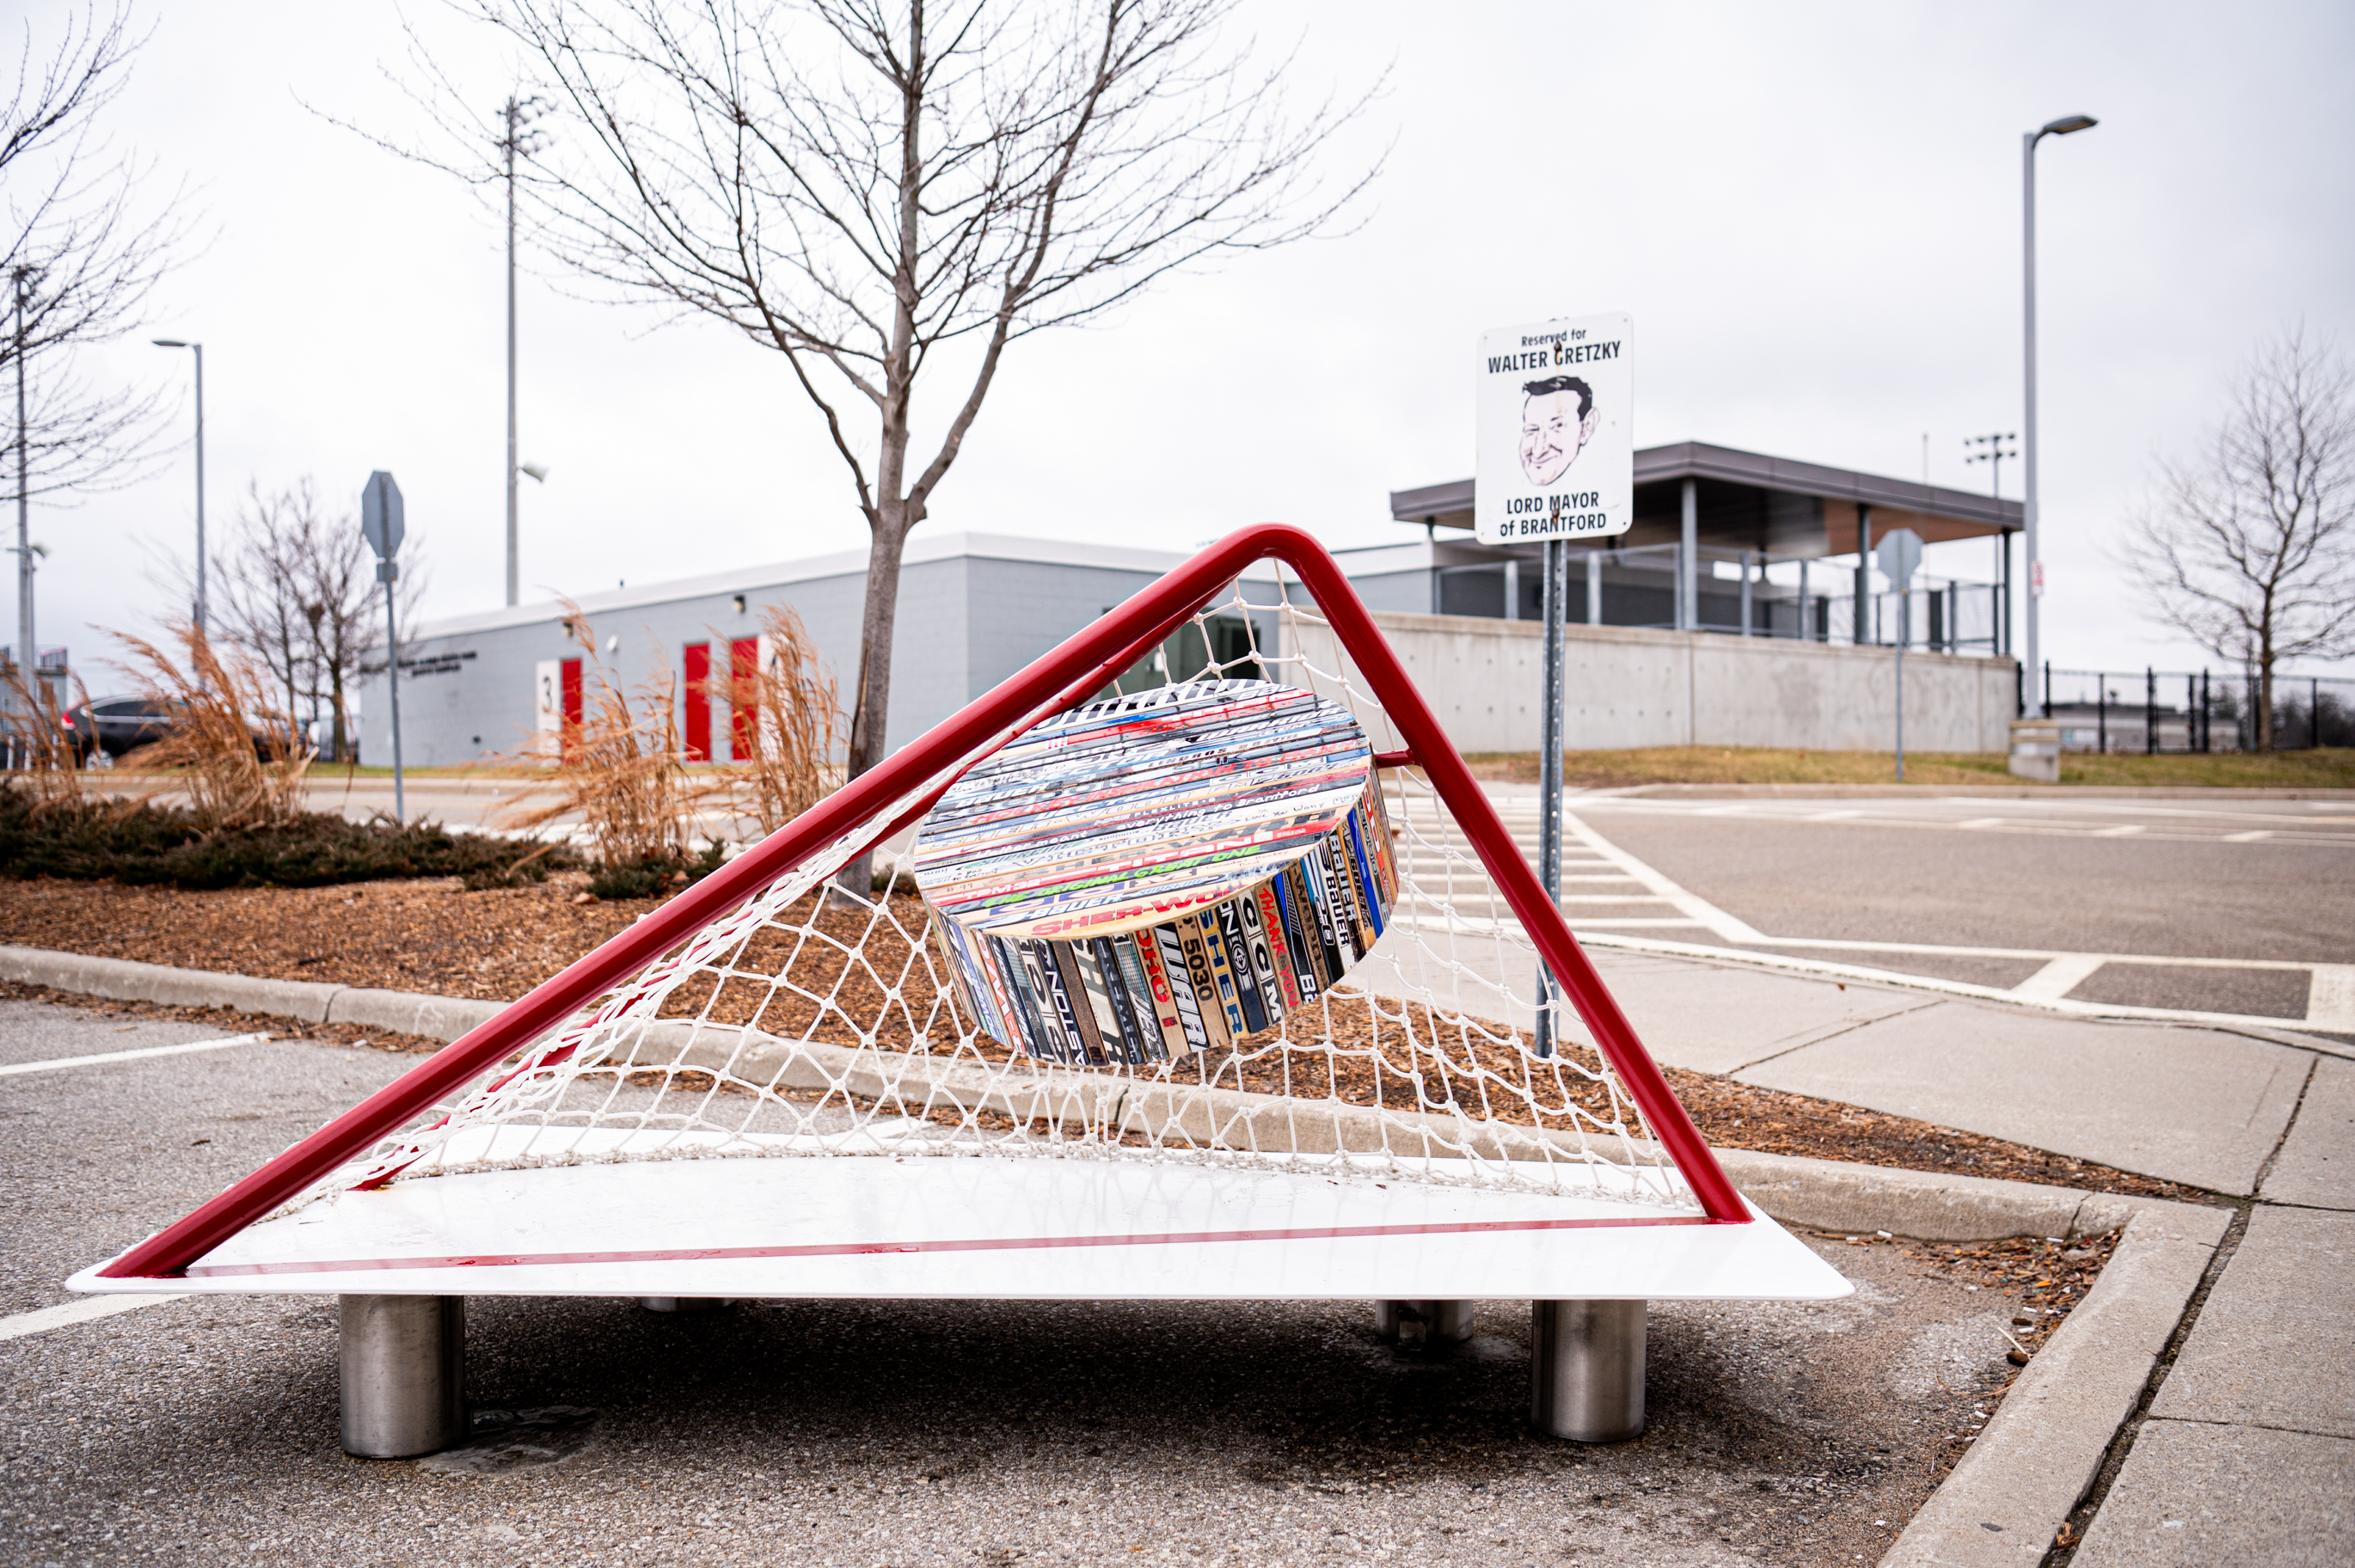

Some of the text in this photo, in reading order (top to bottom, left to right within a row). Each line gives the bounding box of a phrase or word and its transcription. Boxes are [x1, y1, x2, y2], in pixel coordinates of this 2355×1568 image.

[1488, 341, 1621, 373] WALTER GRETZKY
[1521, 328, 1586, 346] Reserved for
[1500, 514, 1606, 536] of BRANTFORD
[1506, 492, 1599, 514] LORD MAYOR
[543, 675, 553, 710] 3
[1161, 689, 1300, 721] TITAN
[972, 795, 1078, 824] HOCKEY
[1085, 763, 1236, 802] INSPIRATION
[1242, 756, 1273, 771] TO
[1279, 738, 1358, 763] MANY
[1147, 746, 1228, 768] LINDROS
[929, 791, 1192, 850] SHER-WOOD
[974, 841, 1032, 860] Walter
[1034, 830, 1089, 848] meant
[1116, 807, 1206, 831] everything
[1213, 800, 1232, 812] to
[1236, 783, 1321, 806] Brantford
[984, 844, 1261, 908] THE ORIGINAL GREAT ONE
[1096, 836, 1252, 872] TITAN
[1182, 939, 1215, 1001] 5030
[1199, 910, 1245, 1033] SHER
[1243, 896, 1283, 1023] CCM
[1258, 886, 1289, 953] THANK
[1276, 964, 1300, 1008] YOU
[969, 977, 999, 1038] POWER
